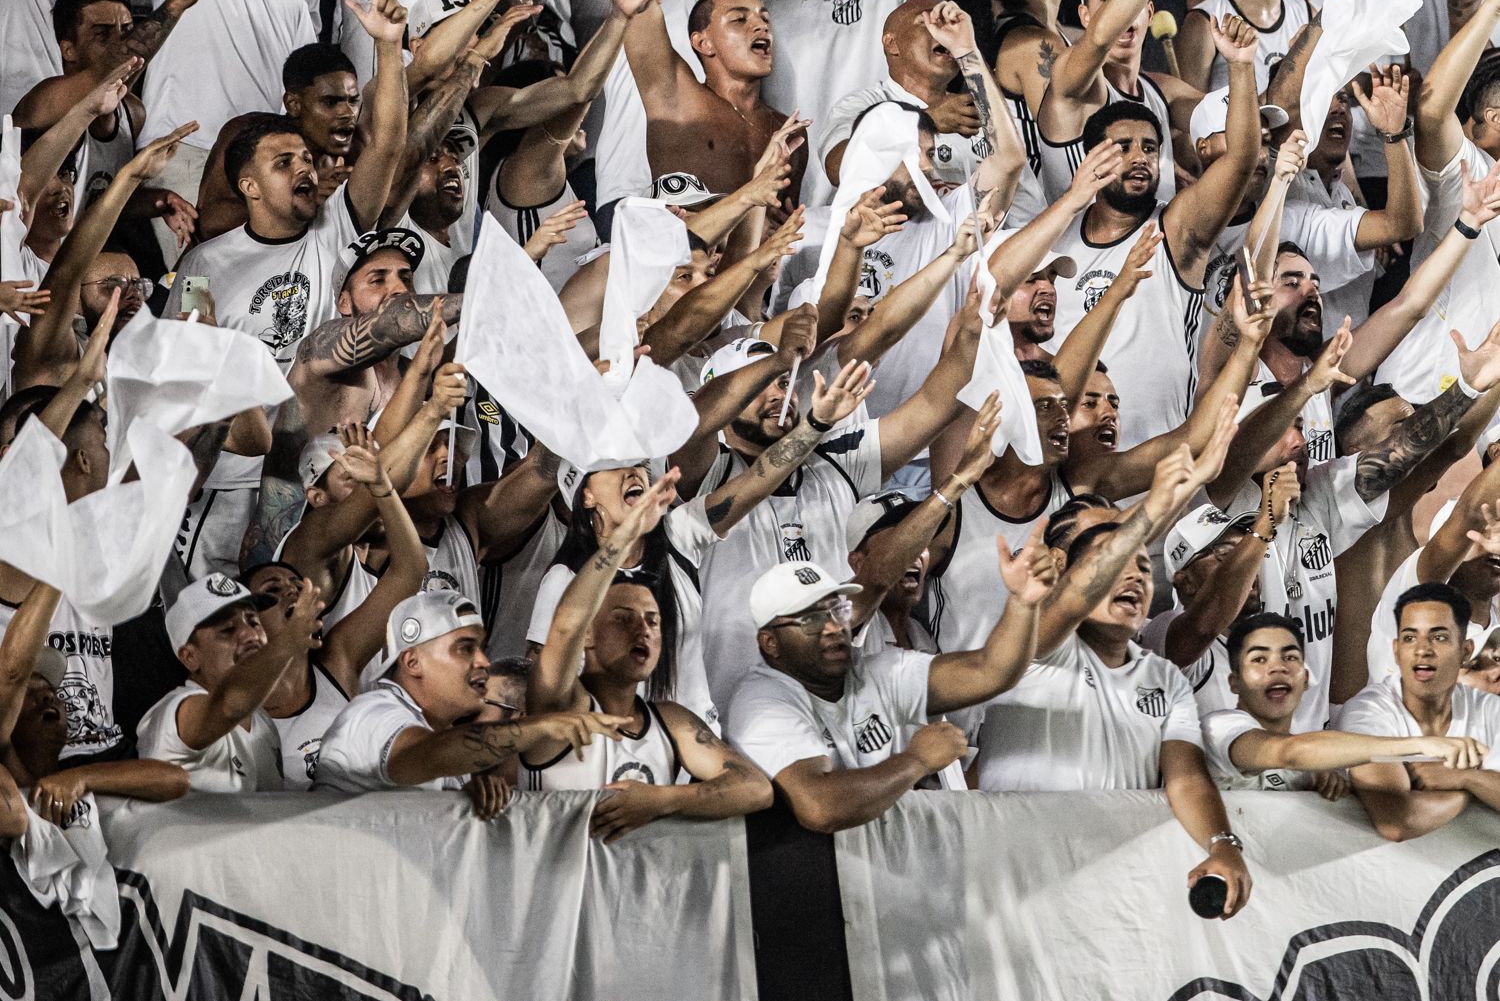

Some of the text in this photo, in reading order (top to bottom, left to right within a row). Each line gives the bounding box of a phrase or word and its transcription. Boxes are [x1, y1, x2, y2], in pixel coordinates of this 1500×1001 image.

[249, 271, 291, 315] TORCIDA
[478, 414, 500, 426] umbro
[563, 465, 578, 490] TJS
[1171, 541, 1188, 561] TJS
